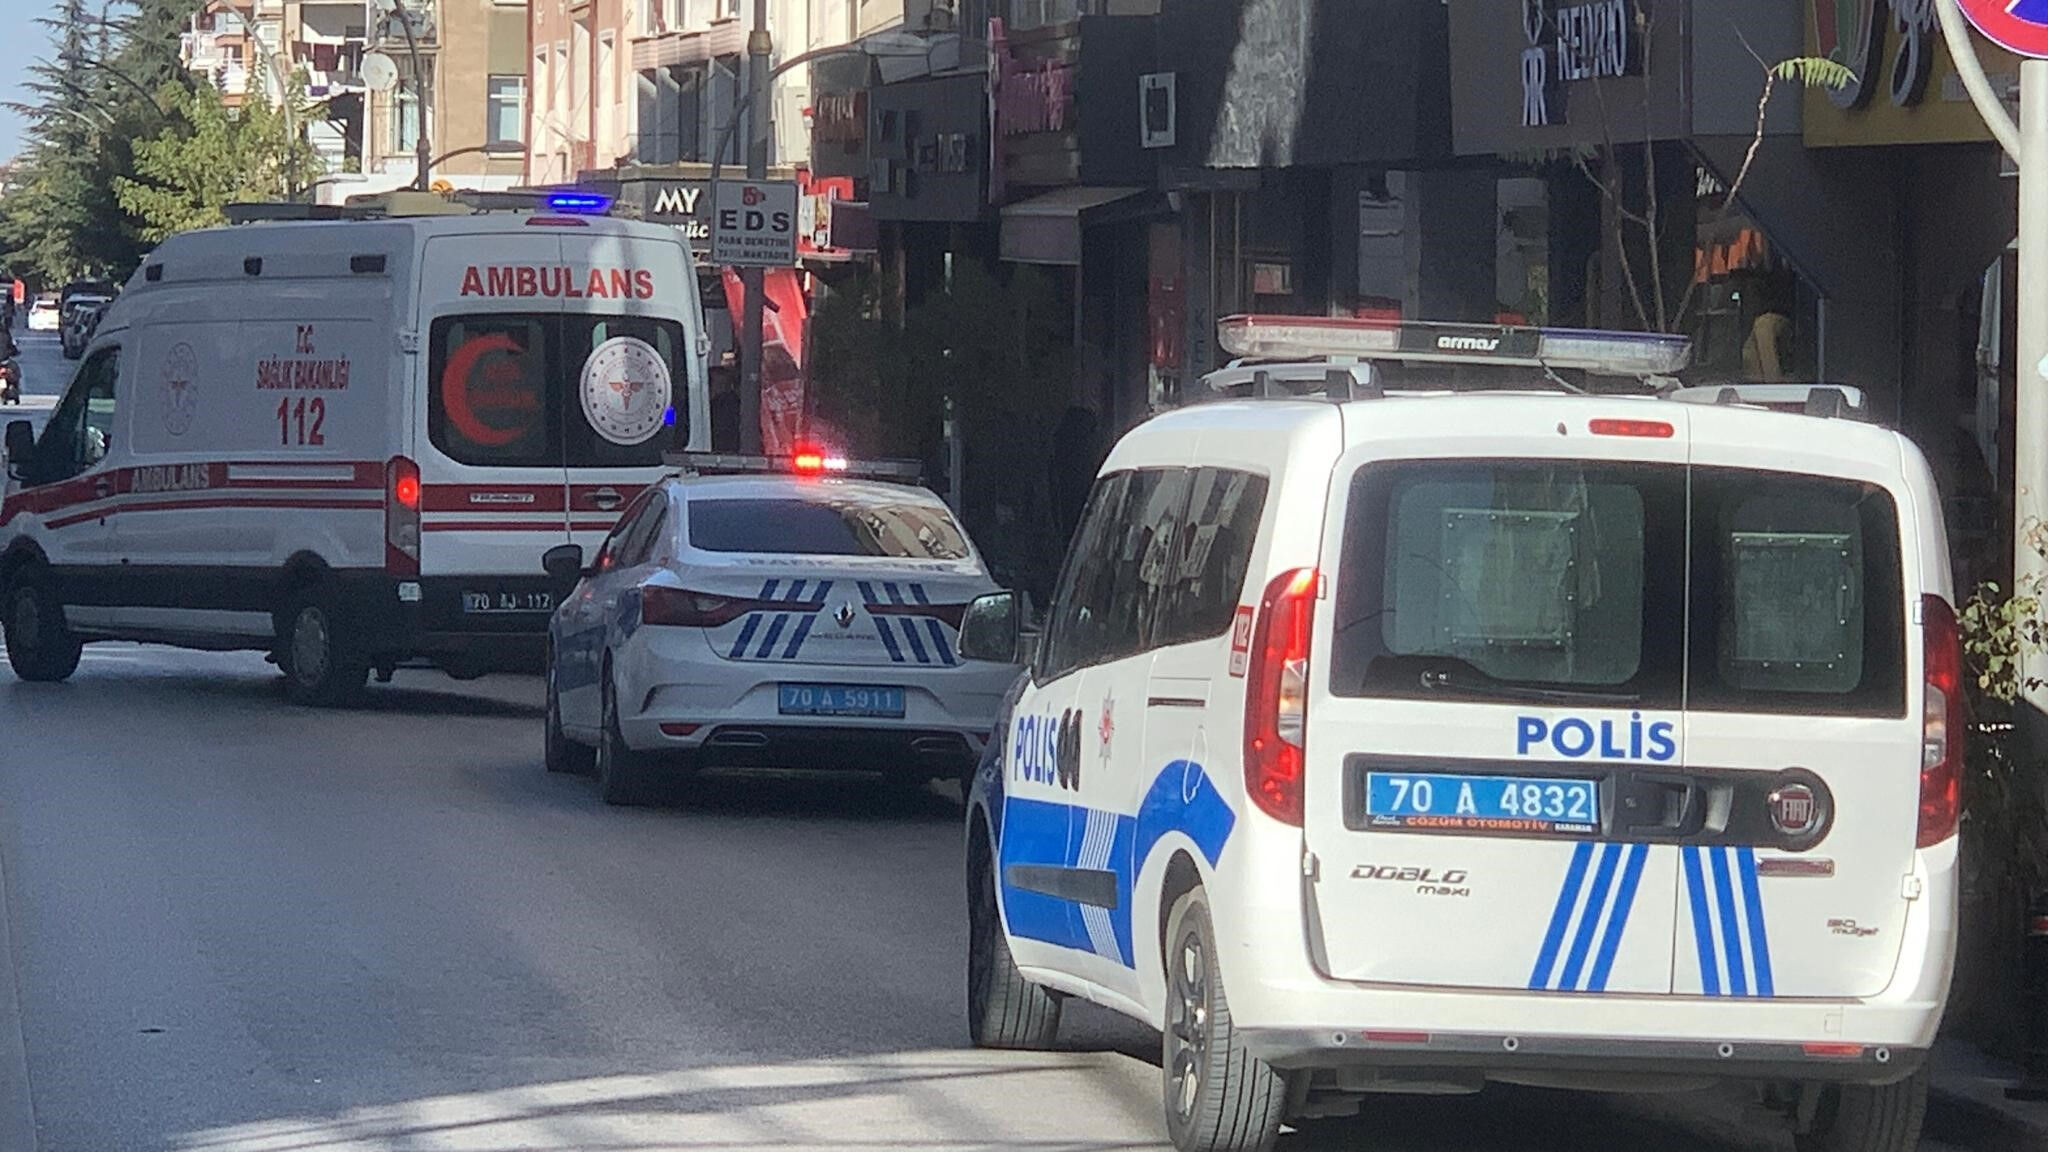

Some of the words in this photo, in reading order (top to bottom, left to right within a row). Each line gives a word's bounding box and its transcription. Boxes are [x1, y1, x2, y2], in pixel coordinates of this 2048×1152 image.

[654, 187, 700, 213] MY
[720, 209, 790, 233] EDS
[460, 265, 654, 299] AMBULANS
[1437, 335, 1500, 351] armas
[276, 397, 325, 445] 112
[132, 463, 211, 492] AMBULANS
[473, 593, 490, 609] 70
[788, 685, 812, 706] 70
[822, 686, 836, 707] A
[844, 687, 893, 708] 5911
[1516, 711, 1676, 761] POLİS
[1388, 779, 1433, 812] 70
[1455, 781, 1477, 816] A
[1500, 783, 1588, 819] 4832
[1782, 799, 1810, 822] FIAT
